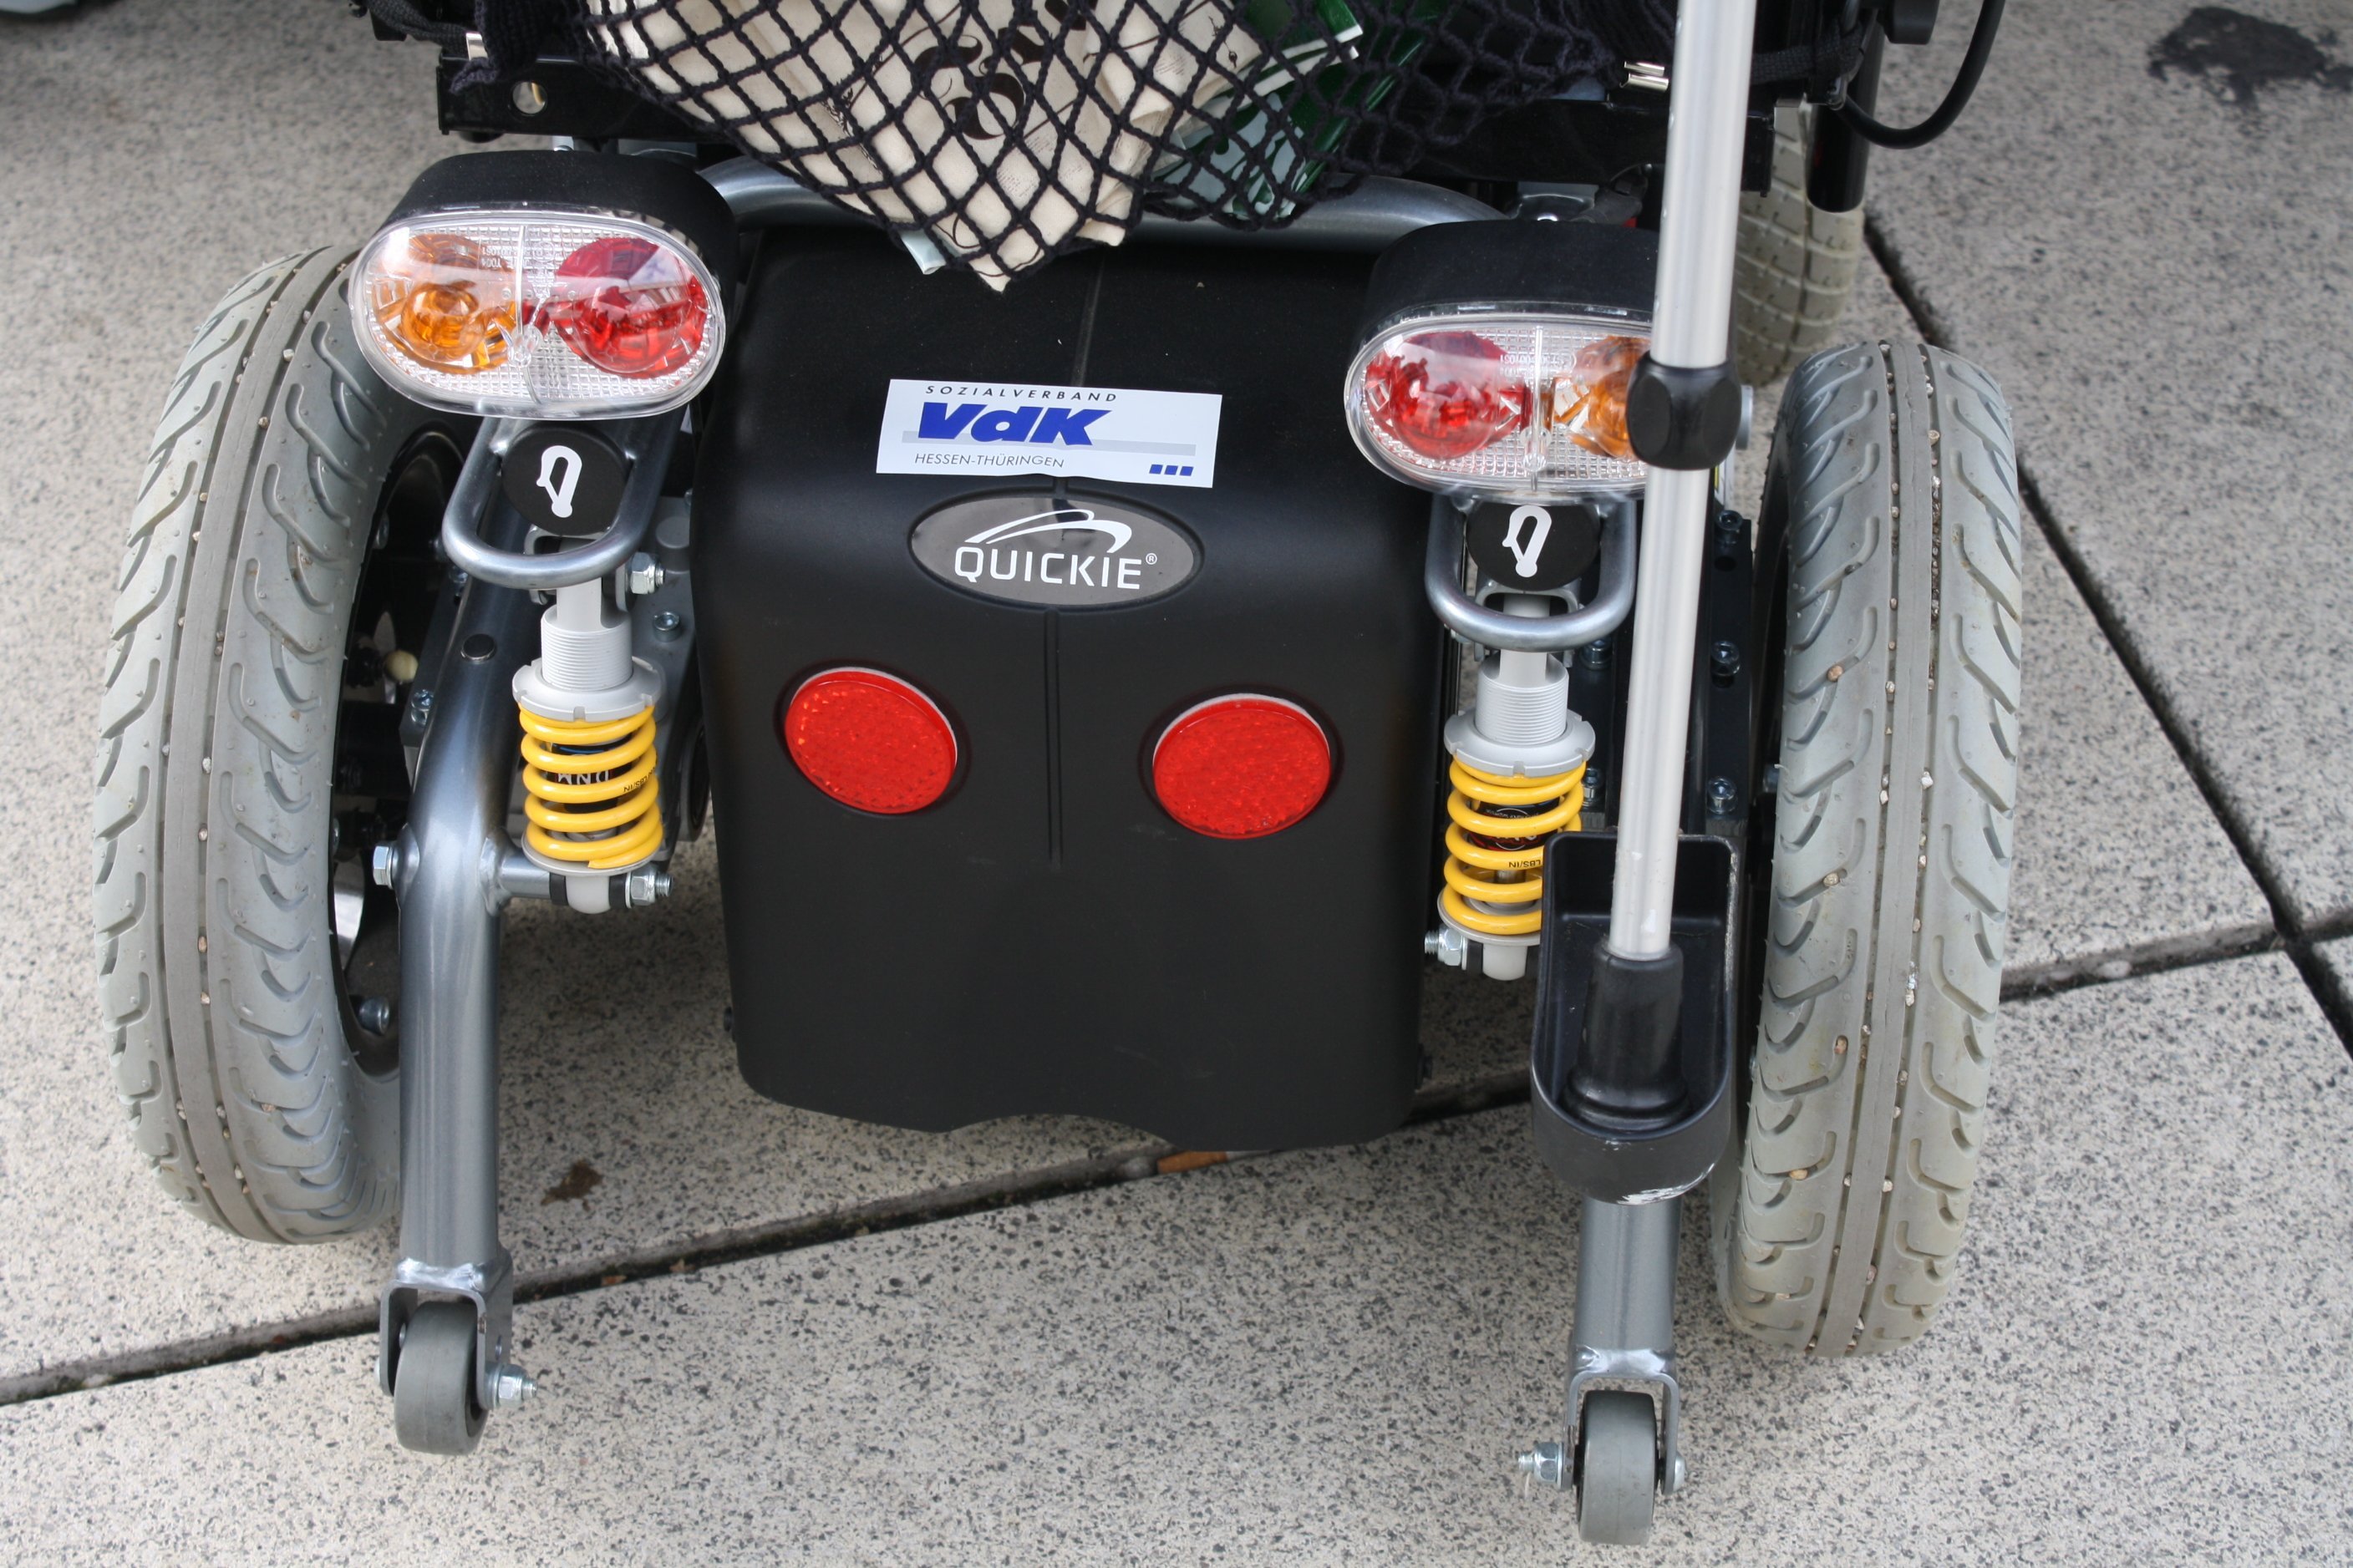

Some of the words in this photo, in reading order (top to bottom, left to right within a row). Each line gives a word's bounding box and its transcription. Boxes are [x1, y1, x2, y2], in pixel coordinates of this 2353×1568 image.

[925, 385, 1118, 402] SOZIALVERBAND
[917, 401, 1112, 446] VdK
[914, 452, 1065, 469] HESSEN-THÜRINGEN
[1508, 859, 1542, 868] LBS/IN
